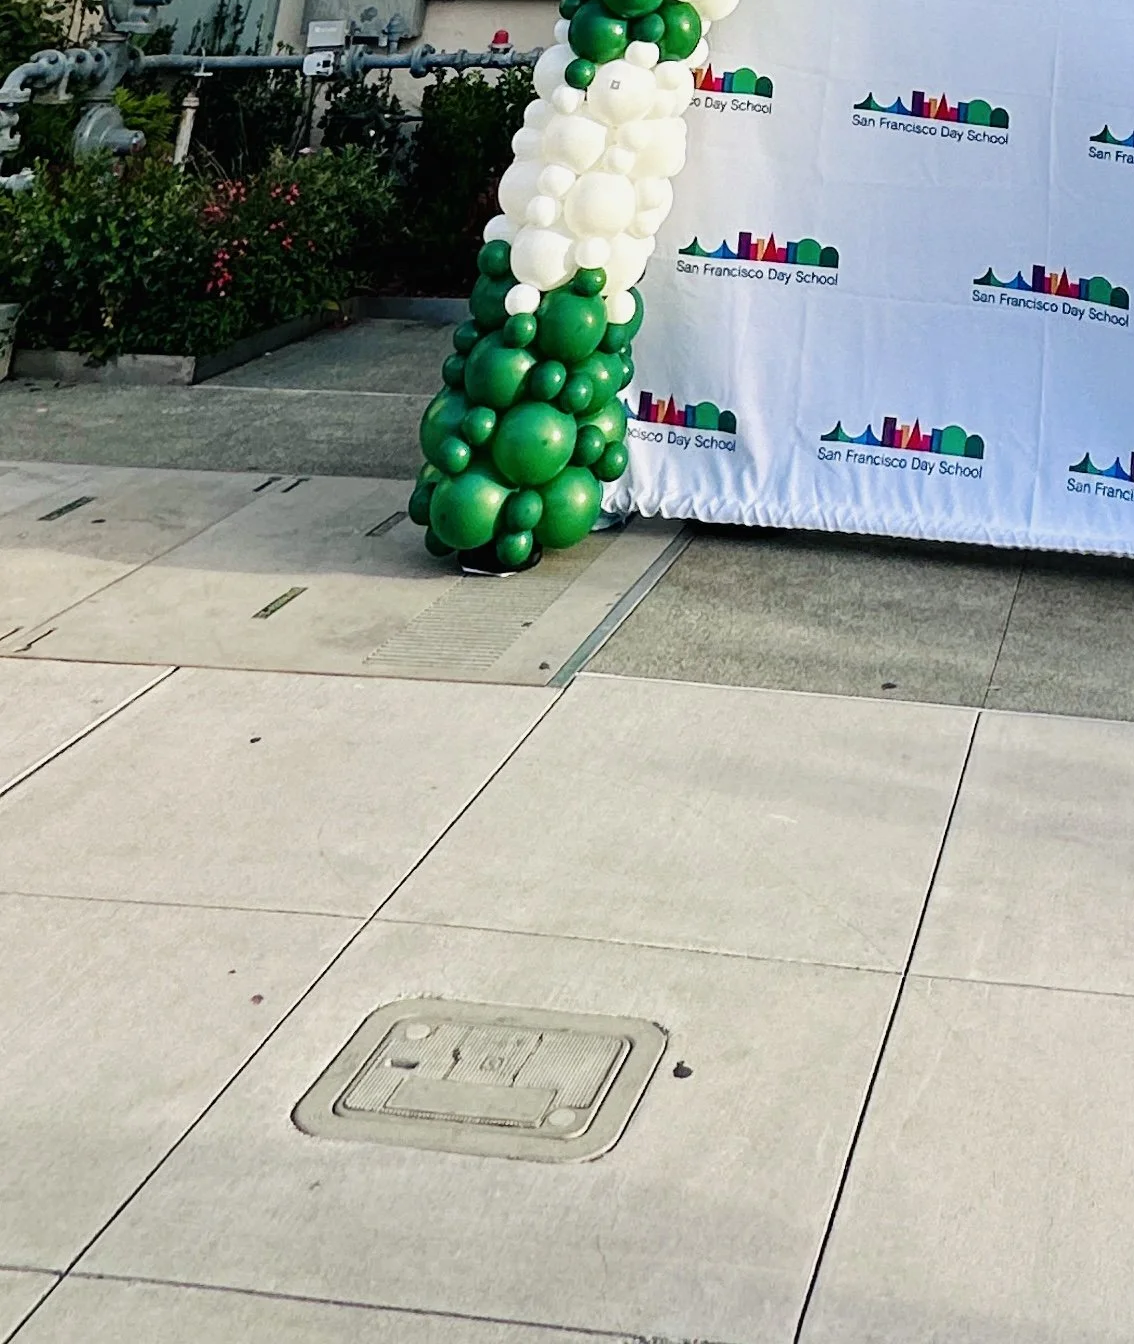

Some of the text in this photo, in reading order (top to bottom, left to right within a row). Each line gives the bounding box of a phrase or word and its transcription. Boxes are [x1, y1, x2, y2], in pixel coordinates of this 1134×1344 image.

[704, 97, 727, 112] Day
[730, 98, 772, 115] School
[851, 114, 1009, 145] San Francisco Day School
[1088, 146, 1111, 160] San
[676, 260, 839, 286] San Francisco Day School
[972, 289, 1130, 327] San Francisco Day School
[667, 431, 691, 450] Day
[694, 434, 736, 452] School
[817, 446, 983, 479] San Francisco Day School
[1066, 478, 1091, 494] San
